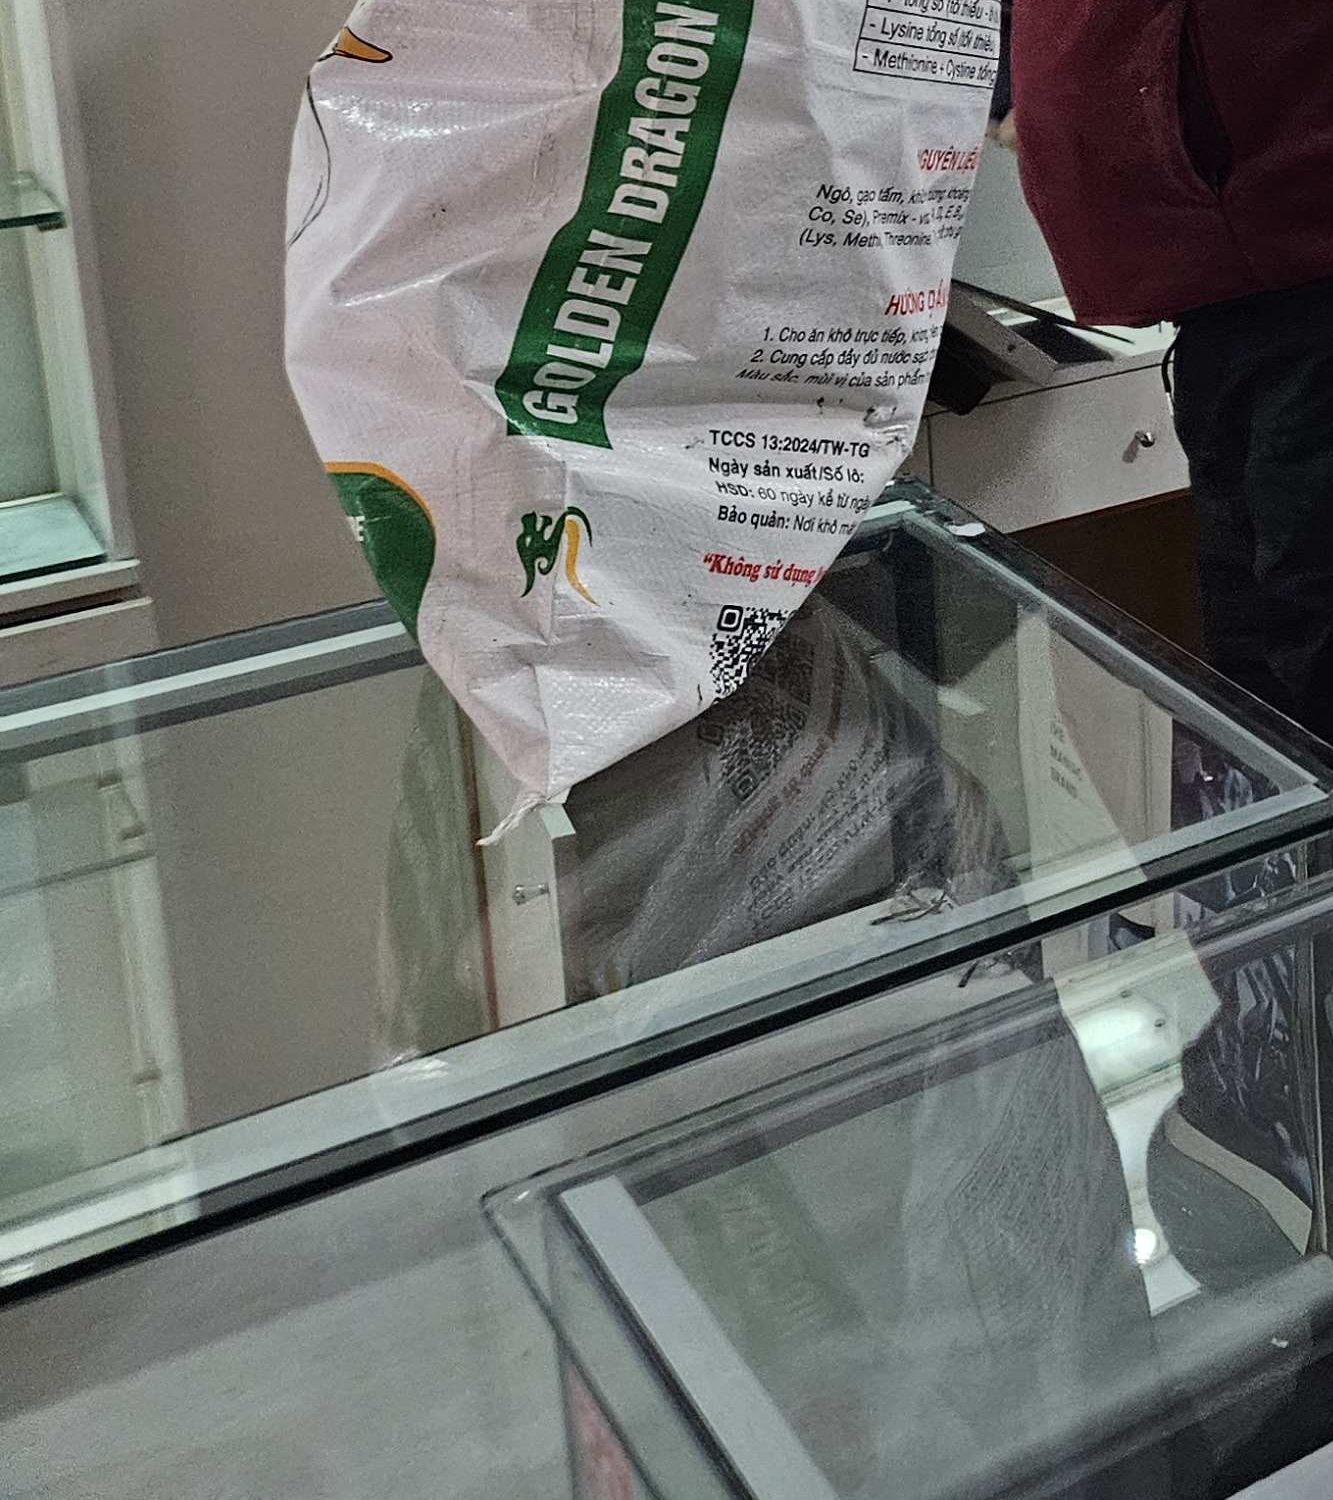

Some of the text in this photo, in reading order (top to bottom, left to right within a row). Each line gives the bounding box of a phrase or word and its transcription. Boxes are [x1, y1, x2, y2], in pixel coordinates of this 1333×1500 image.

[880, 17, 924, 41] Lysine
[607, 1, 720, 224] DRAGON
[917, 145, 957, 171] GUYÊN
[816, 184, 854, 205] Ngô,
[808, 206, 836, 225] Co,
[842, 210, 870, 228] Se),
[799, 228, 837, 247] (Lys,
[522, 229, 653, 424] GOLDEN
[763, 327, 774, 342] 1.
[779, 327, 806, 343] Cho
[808, 328, 825, 343] ăn
[828, 327, 852, 343] khô
[751, 349, 764, 363] 2.
[769, 349, 808, 368] Cung
[810, 348, 834, 368] cấp
[849, 371, 872, 388] của
[874, 370, 895, 387] sản
[709, 429, 871, 458] TCCS 13:2024/TW-TG
[709, 456, 749, 478] Ngày
[753, 459, 781, 478] sản
[757, 486, 777, 500] 60
[780, 486, 814, 508] ngày
[717, 505, 747, 525] Bảo
[750, 510, 791, 531] quản:
[793, 515, 814, 533] Nơi
[763, 559, 782, 580] sử
[783, 564, 816, 589] dụng
